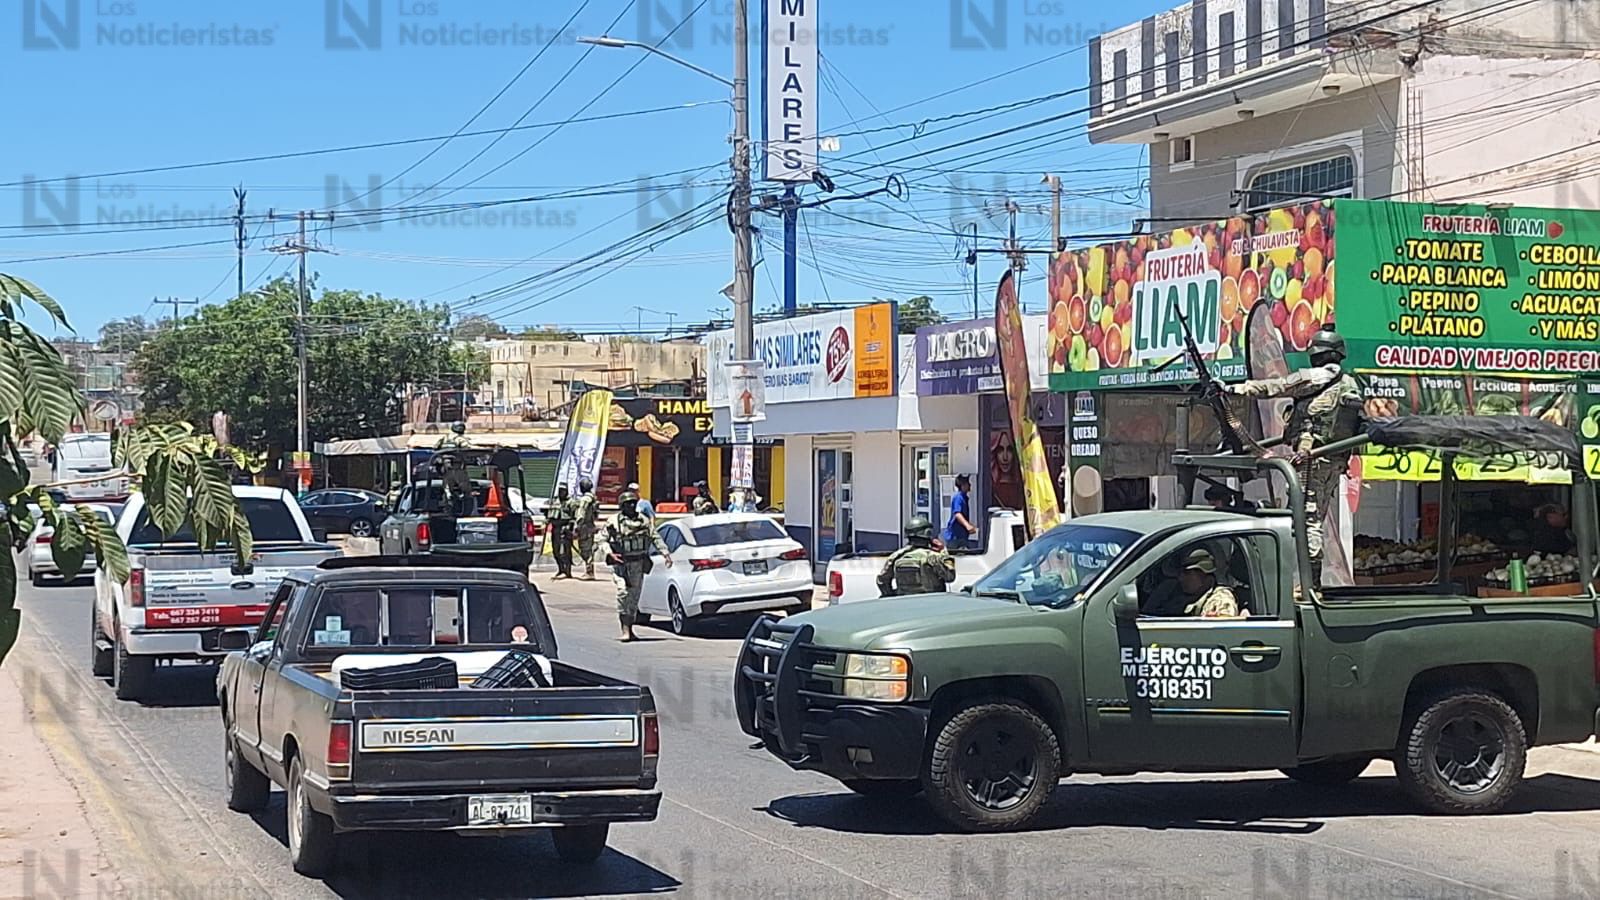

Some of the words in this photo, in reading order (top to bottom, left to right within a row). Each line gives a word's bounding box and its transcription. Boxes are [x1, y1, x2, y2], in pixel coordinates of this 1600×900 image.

[1424, 210, 1500, 235] FRUTERÍA
[1505, 219, 1544, 237] LIAM
[1251, 229, 1300, 253] CHULAVISTA
[1407, 240, 1483, 262] TOMATE
[1147, 244, 1205, 282] FRUTERÍA
[1530, 244, 1600, 266] CEBOLL
[1382, 264, 1431, 285] PAPA
[1434, 266, 1506, 288] BLANCA
[1538, 266, 1600, 290] LIMÓN
[1410, 290, 1479, 312] PEPINO
[1135, 278, 1218, 351] LIAM
[1400, 312, 1485, 337] PLÁTANO
[1540, 320, 1553, 339] Y
[1556, 316, 1598, 340] MÁS
[775, 331, 822, 368] SIMILARES
[1376, 347, 1457, 369] CALIDAD
[1460, 349, 1475, 369] Y
[1477, 349, 1541, 370] MEJOR
[1120, 643, 1227, 665] EJÉRCITO
[1122, 664, 1225, 679] MEXICANO
[1136, 678, 1212, 700] 3318351
[382, 728, 455, 744] NISSAN
